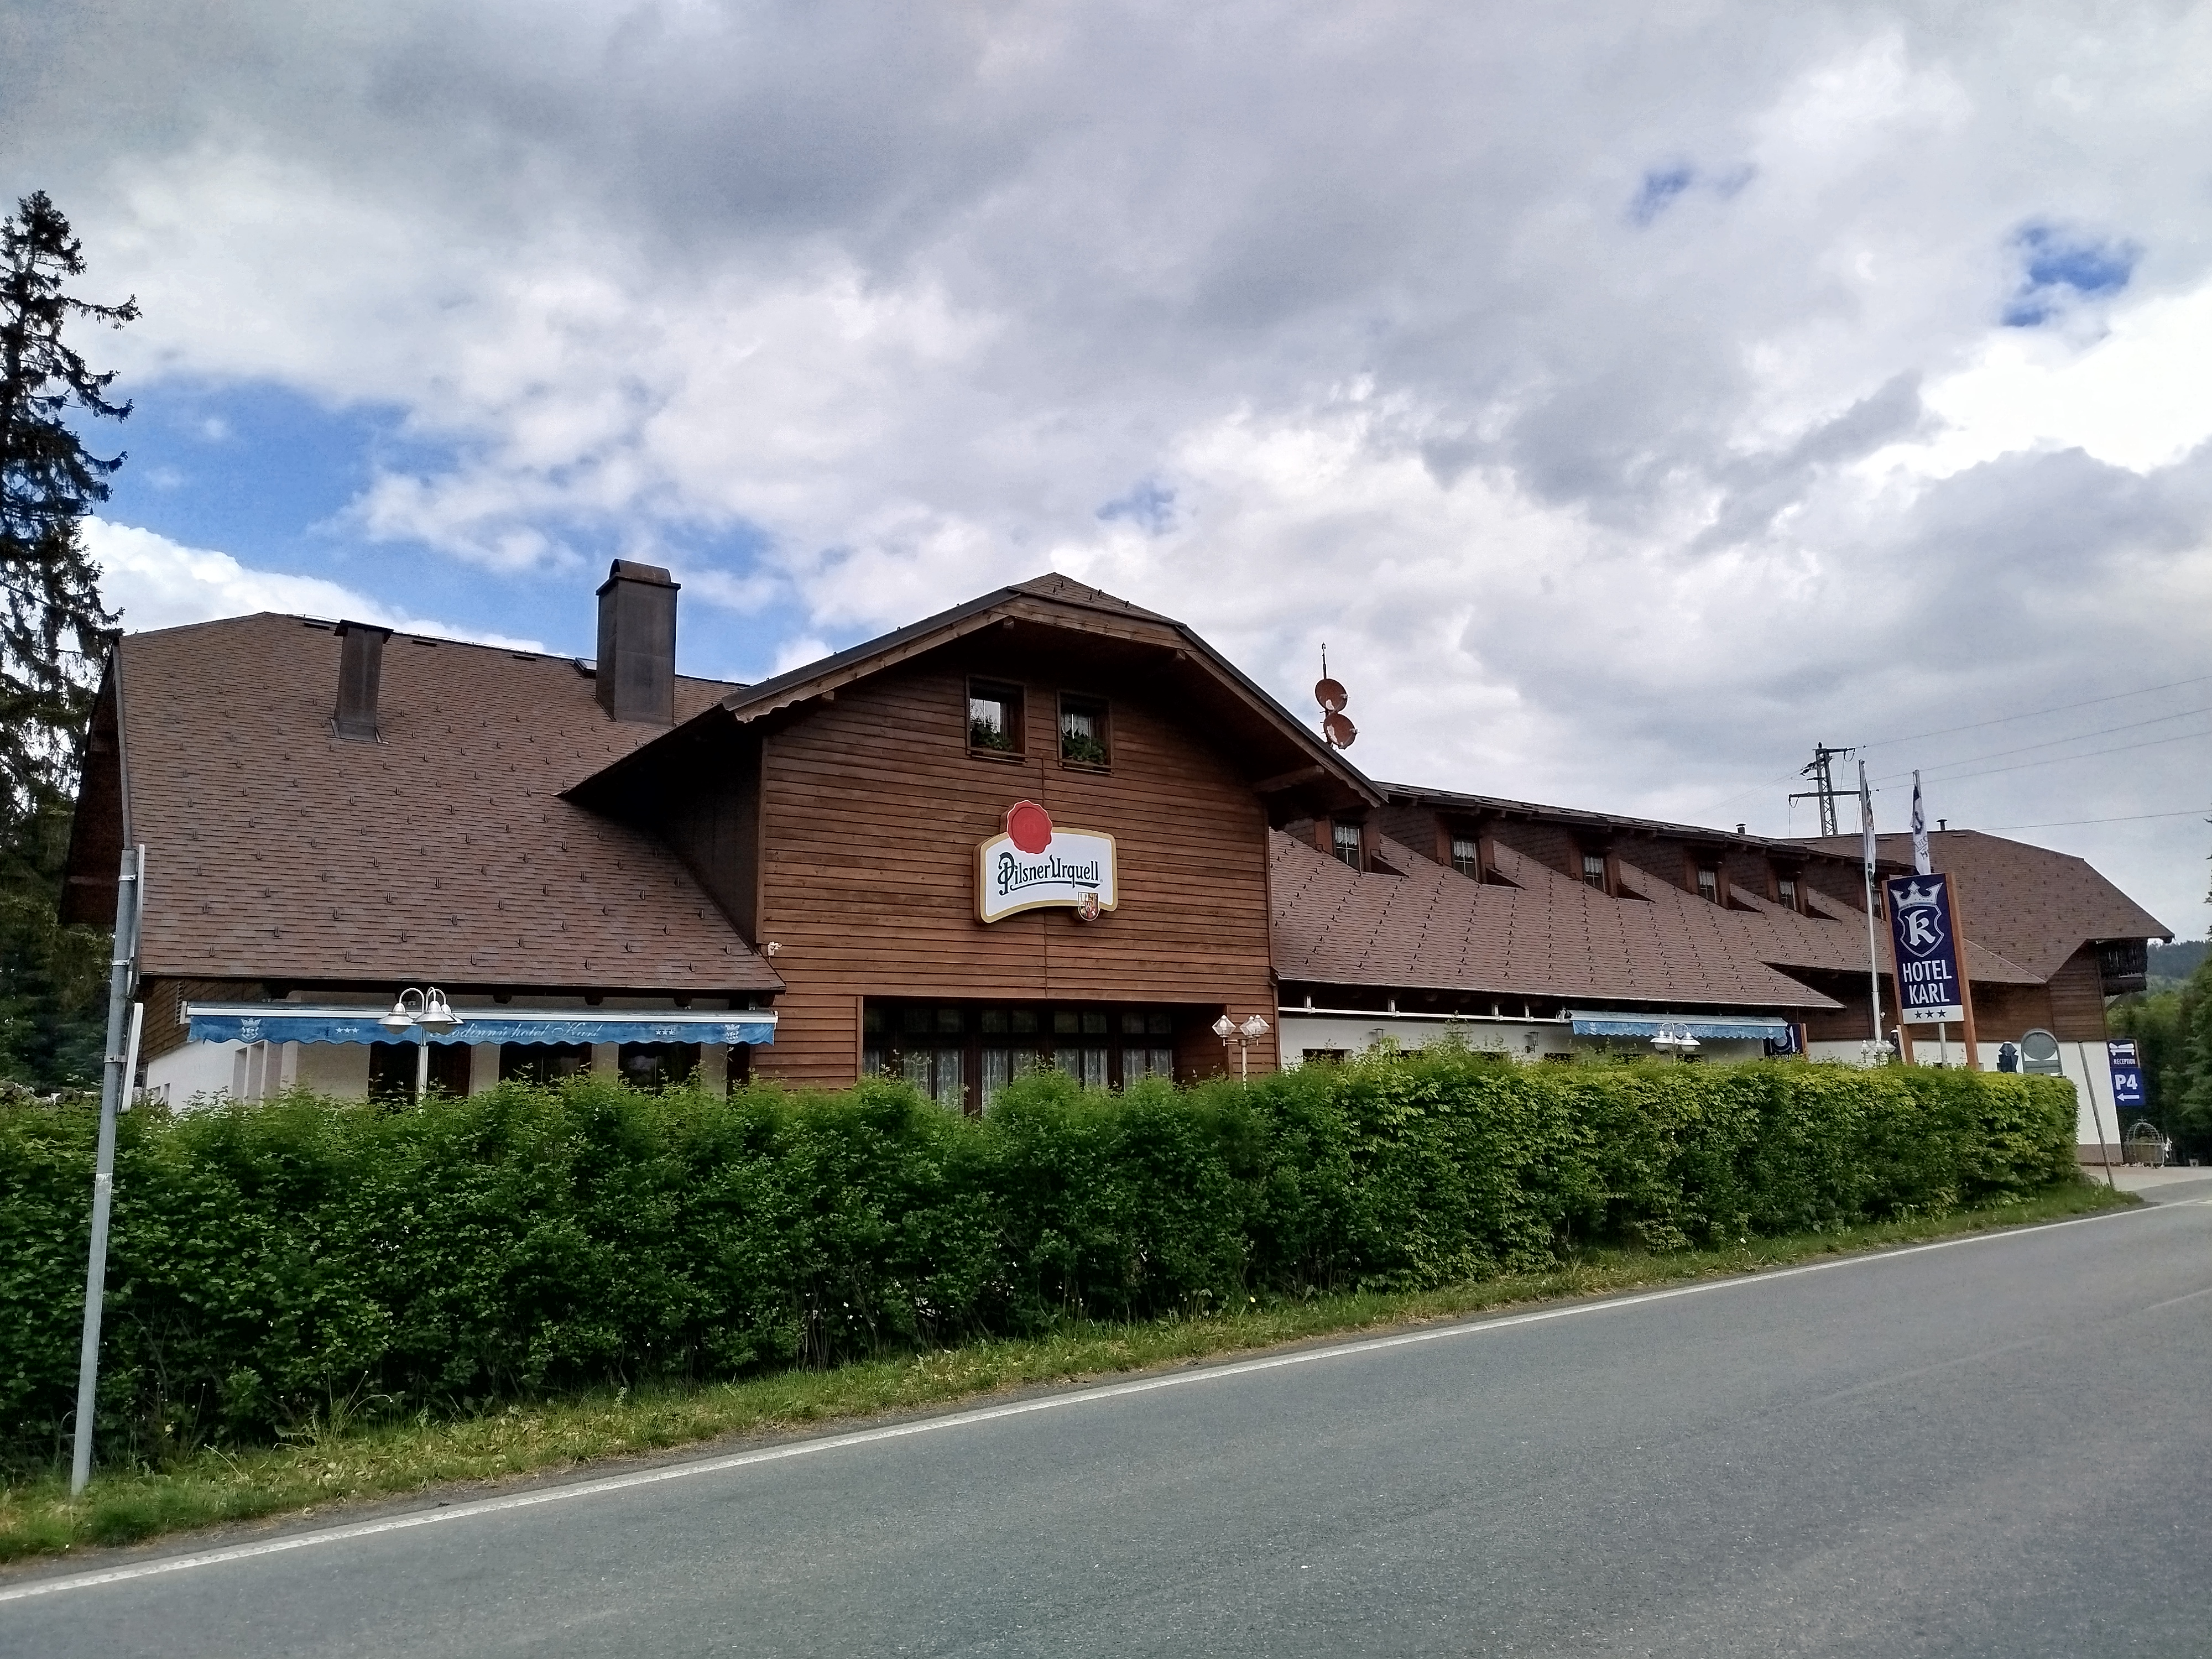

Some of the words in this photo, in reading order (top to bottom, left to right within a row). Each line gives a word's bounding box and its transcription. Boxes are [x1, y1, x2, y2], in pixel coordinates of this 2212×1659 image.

[998, 852, 1051, 896] Pilsner
[1050, 854, 1099, 889] Urquell
[1902, 959, 1952, 983] HOTEL
[1908, 982, 1950, 1004] KARL
[430, 1023, 508, 1044] odinný
[510, 1024, 550, 1038] hotel
[2115, 1074, 2138, 1090] P4
